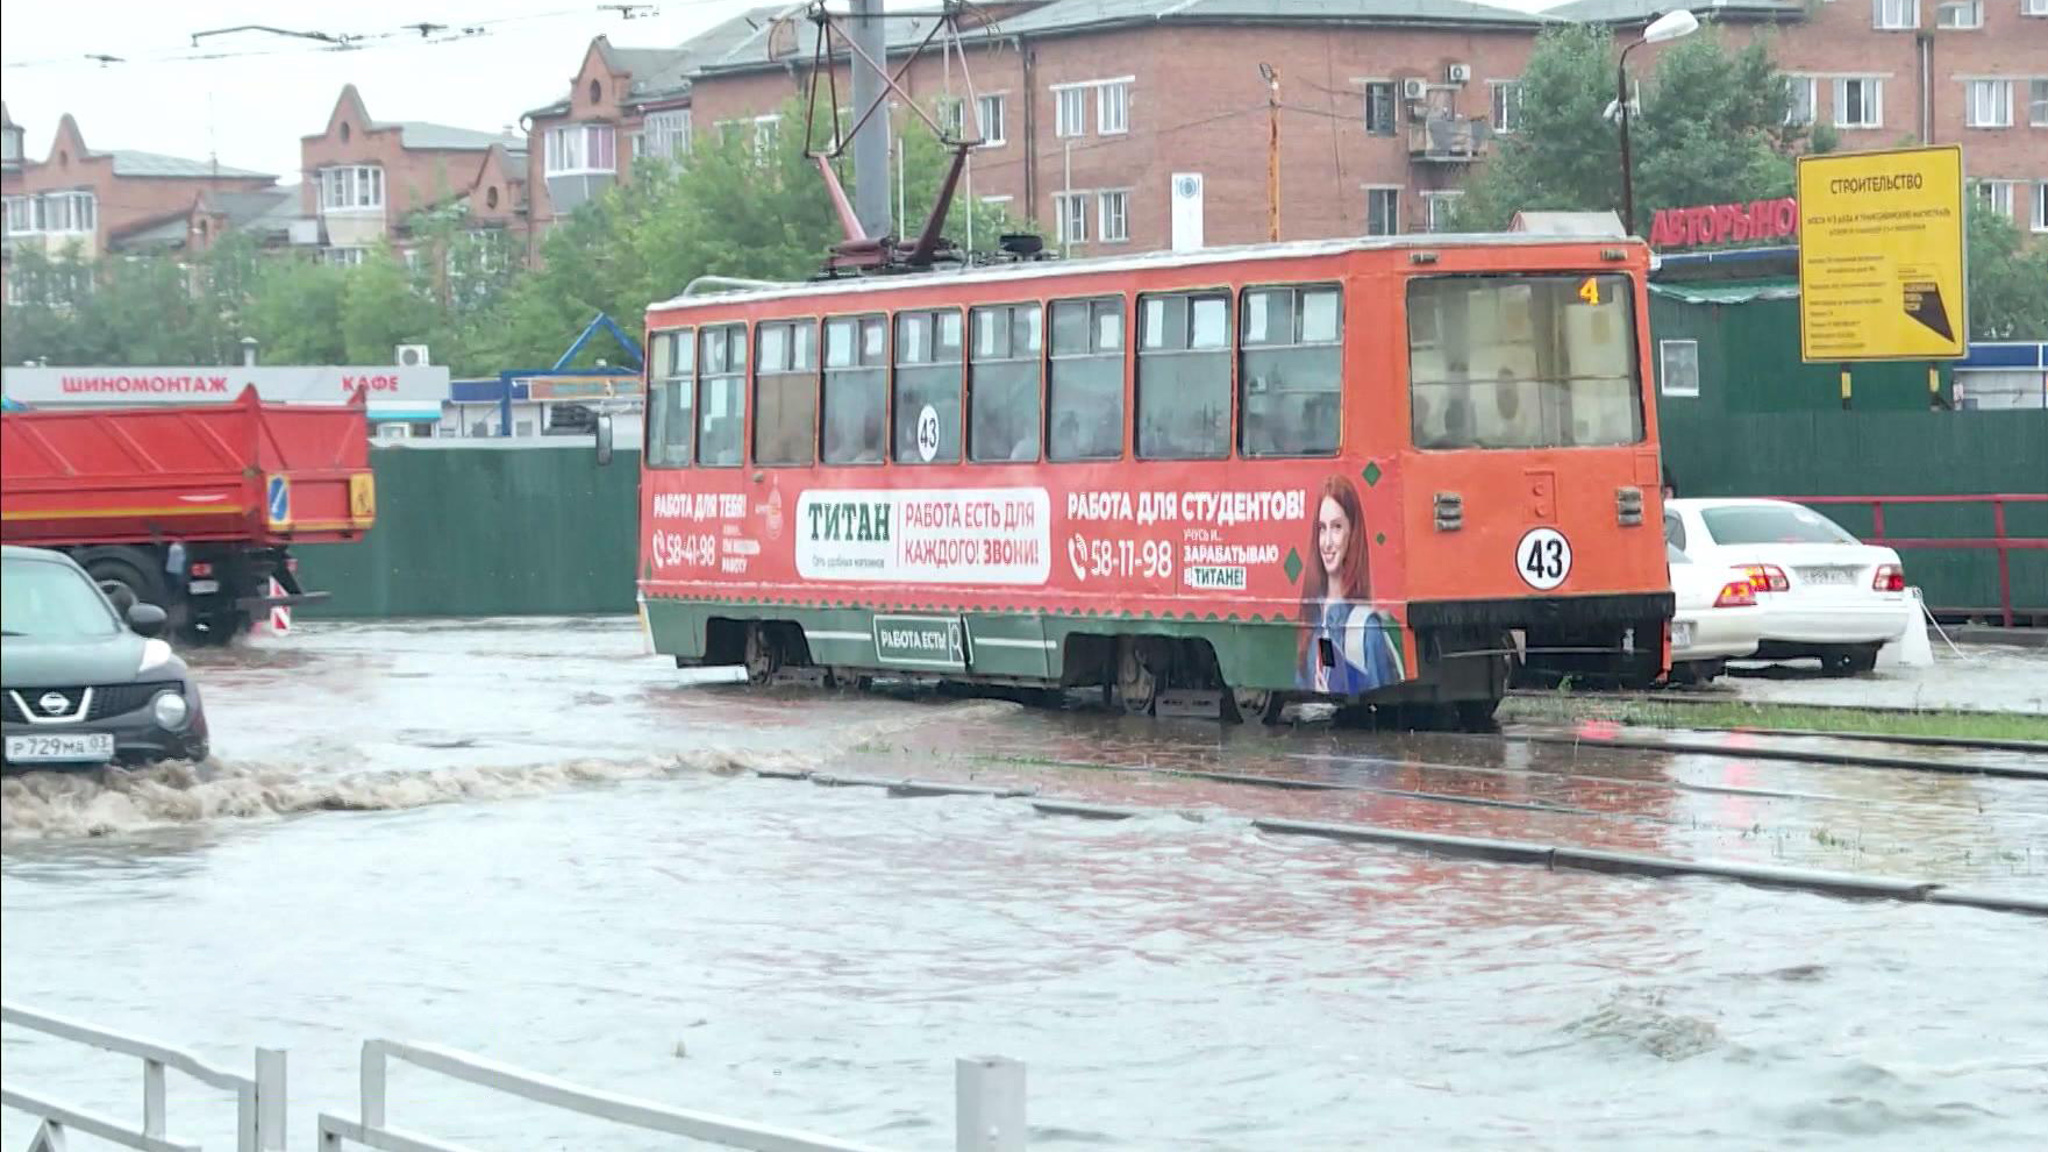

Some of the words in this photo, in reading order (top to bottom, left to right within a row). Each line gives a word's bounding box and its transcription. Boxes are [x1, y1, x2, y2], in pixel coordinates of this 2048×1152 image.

[1830, 172, 1923, 195] СТРОИТЕЛЬСТВО
[1650, 197, 1799, 246] АВТОРЫНО
[1580, 277, 1599, 306] 4
[62, 376, 228, 394] ШИНОМОНТАЖ
[342, 374, 399, 393] КАФЕ
[920, 417, 937, 448] 43
[653, 493, 693, 518] РАБОТА
[693, 493, 717, 522] ДЛЯ
[808, 502, 891, 541] ТИТАН
[905, 502, 963, 528] РАБОТА
[965, 502, 1001, 528] ЕСТЬ
[1004, 502, 1035, 531] ДЛЯ
[1067, 492, 1133, 520] РАБОТА
[1137, 491, 1177, 525] ДЛЯ
[1181, 489, 1306, 526] СТУДЕНТОВ!
[905, 539, 980, 568] КАЖДОГО!
[983, 539, 1039, 565] ЗВОНИ!
[1090, 539, 1173, 578] 58-11-98
[1183, 544, 1279, 565] ЗАРАБАТЫВАЮ
[1526, 538, 1563, 579] 43
[1194, 567, 1244, 586] ТИТАНЕ!
[881, 629, 922, 650] РАБОТА
